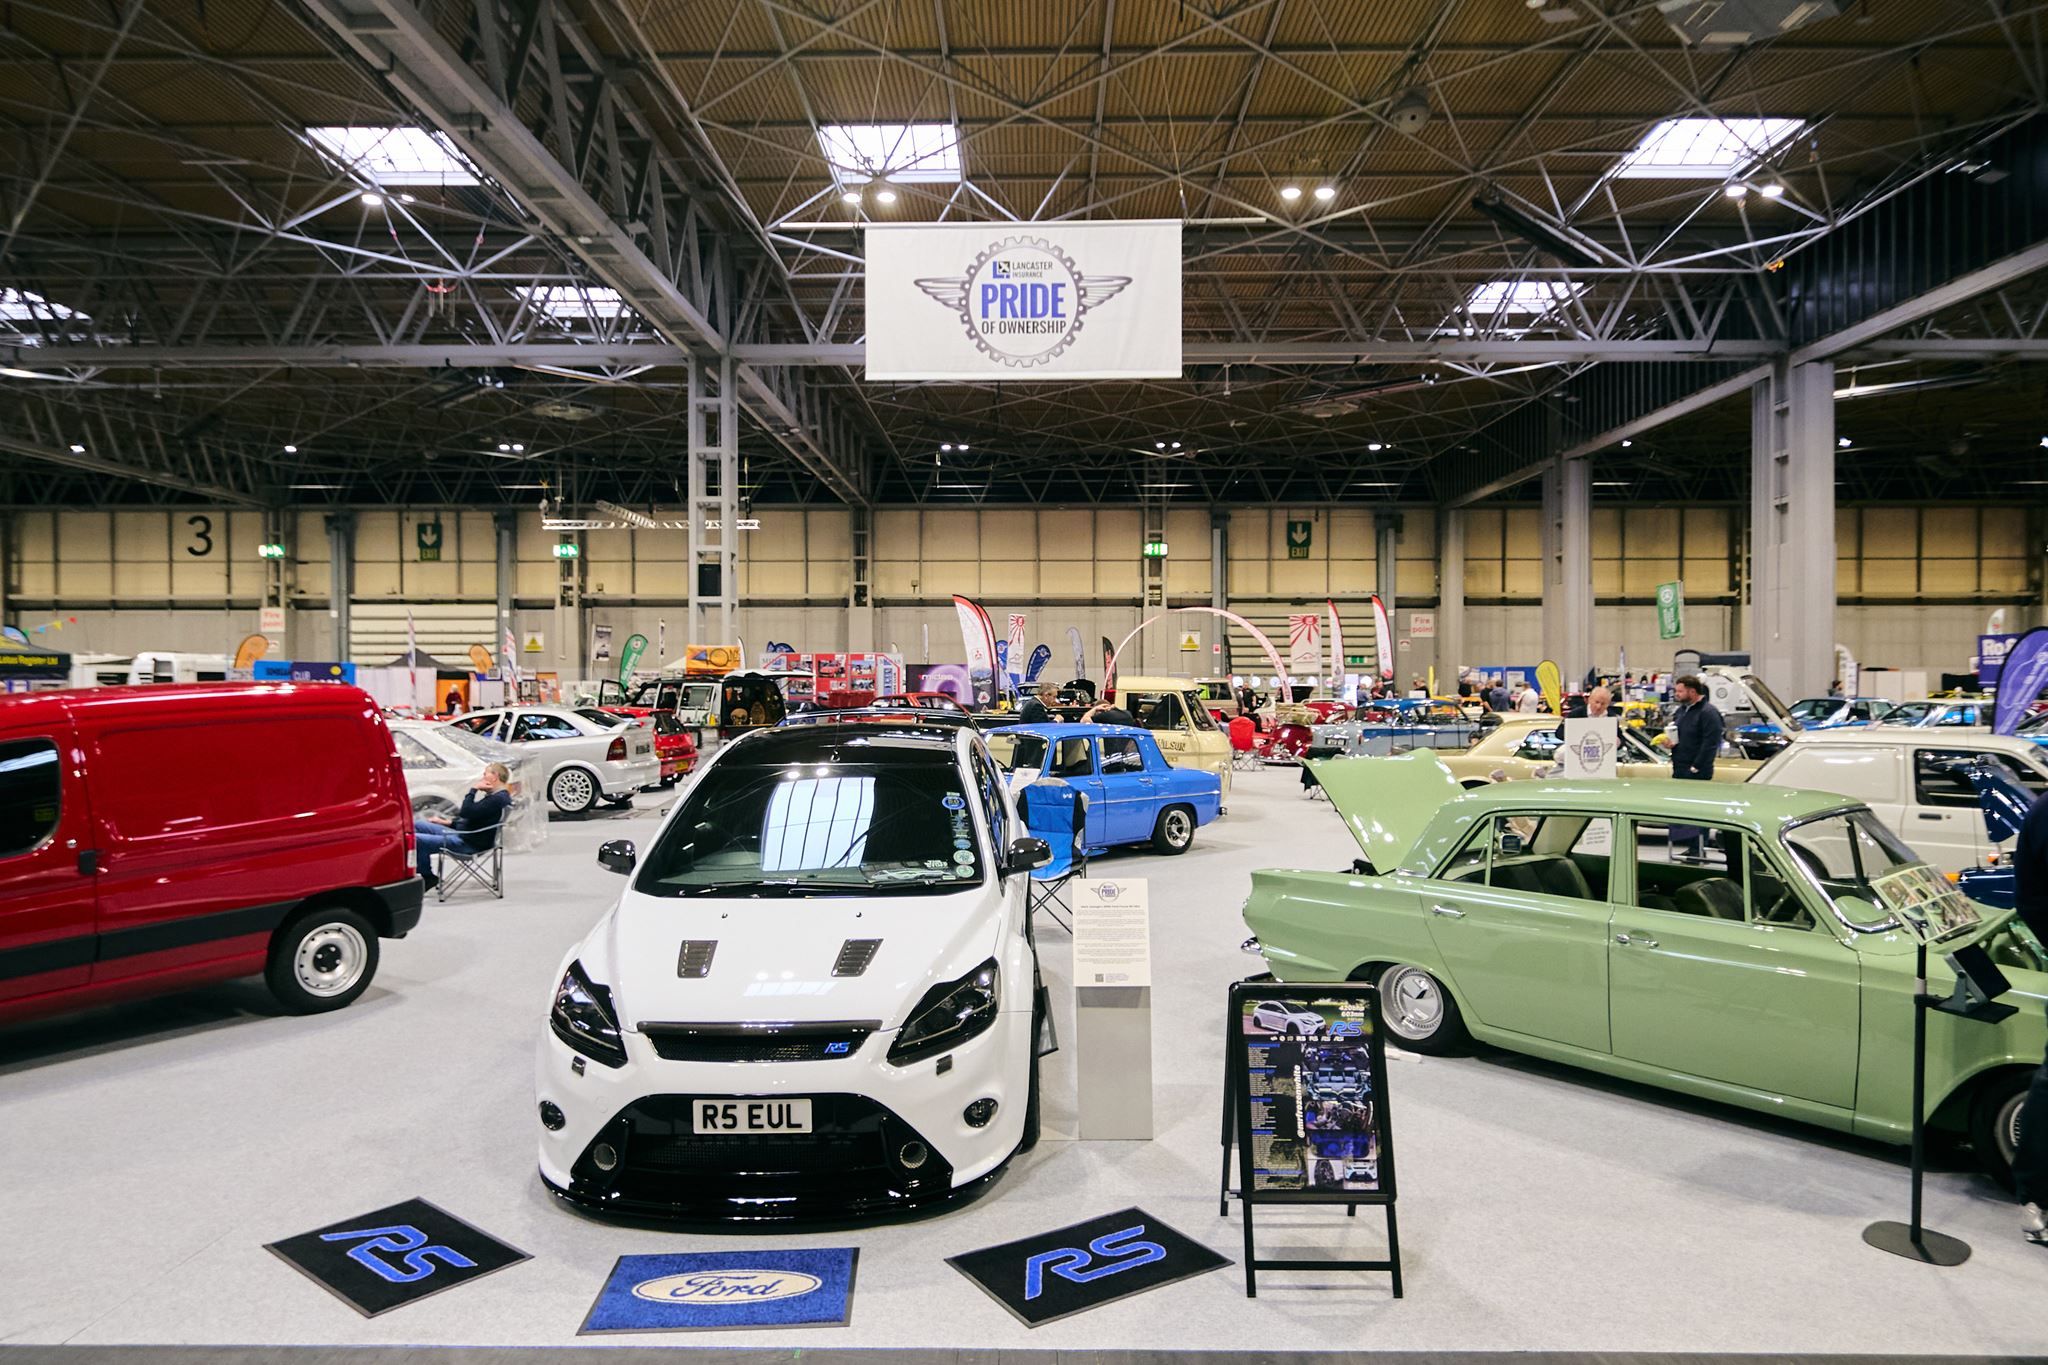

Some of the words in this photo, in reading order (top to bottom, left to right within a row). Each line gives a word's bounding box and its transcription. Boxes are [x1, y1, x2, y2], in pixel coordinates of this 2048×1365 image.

[1012, 261, 1053, 270] LANCASTER
[981, 283, 1066, 319] PRIDE
[981, 321, 995, 334] OF
[999, 320, 1067, 334] OWNERSHIP
[187, 515, 212, 557] 3
[1291, 547, 1308, 558] EXIT
[1411, 626, 1433, 634] point
[1328, 1021, 1364, 1036] RS
[824, 1042, 850, 1054] RS
[702, 1104, 738, 1129] R5
[319, 1224, 478, 1283] RS
[1025, 1224, 1167, 1300] RS
[671, 1275, 783, 1297] Ford
